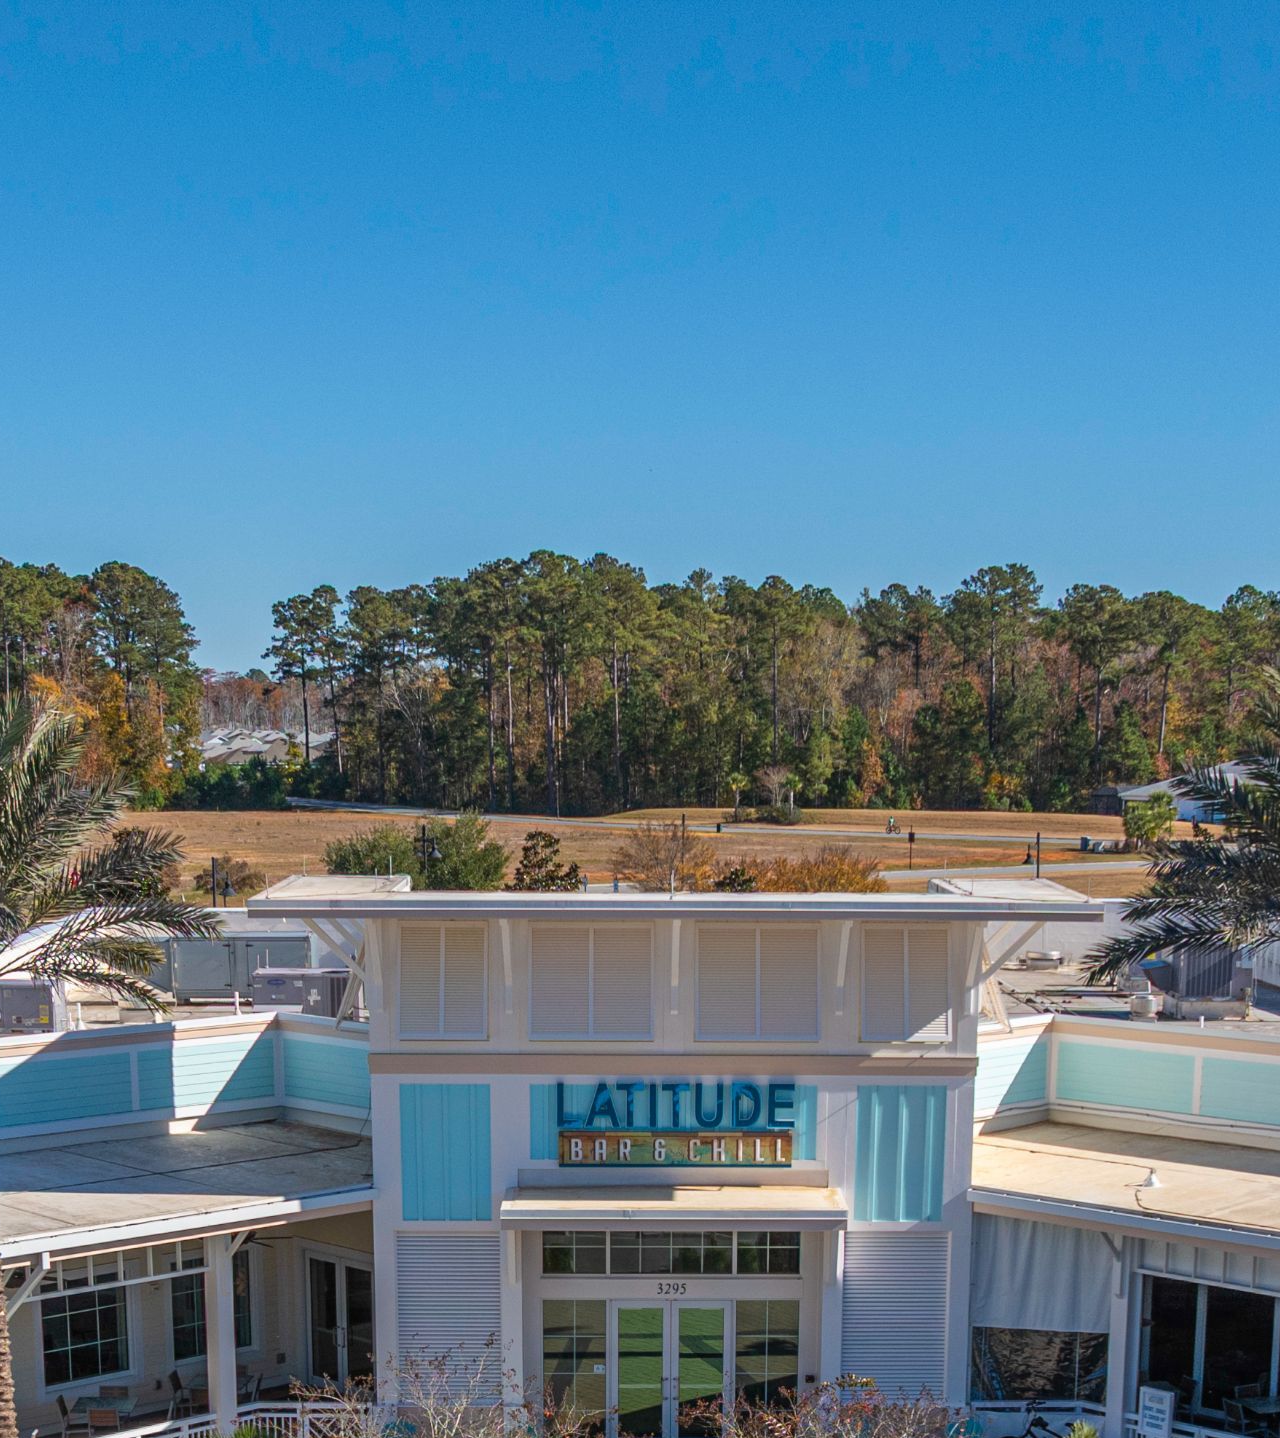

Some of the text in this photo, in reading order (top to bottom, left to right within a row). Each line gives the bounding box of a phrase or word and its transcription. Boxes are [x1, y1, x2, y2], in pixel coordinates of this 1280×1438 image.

[556, 1081, 796, 1128] LATITUDE
[570, 1138, 786, 1162] BAR & CHILL
[656, 1282, 687, 1296] 3295
